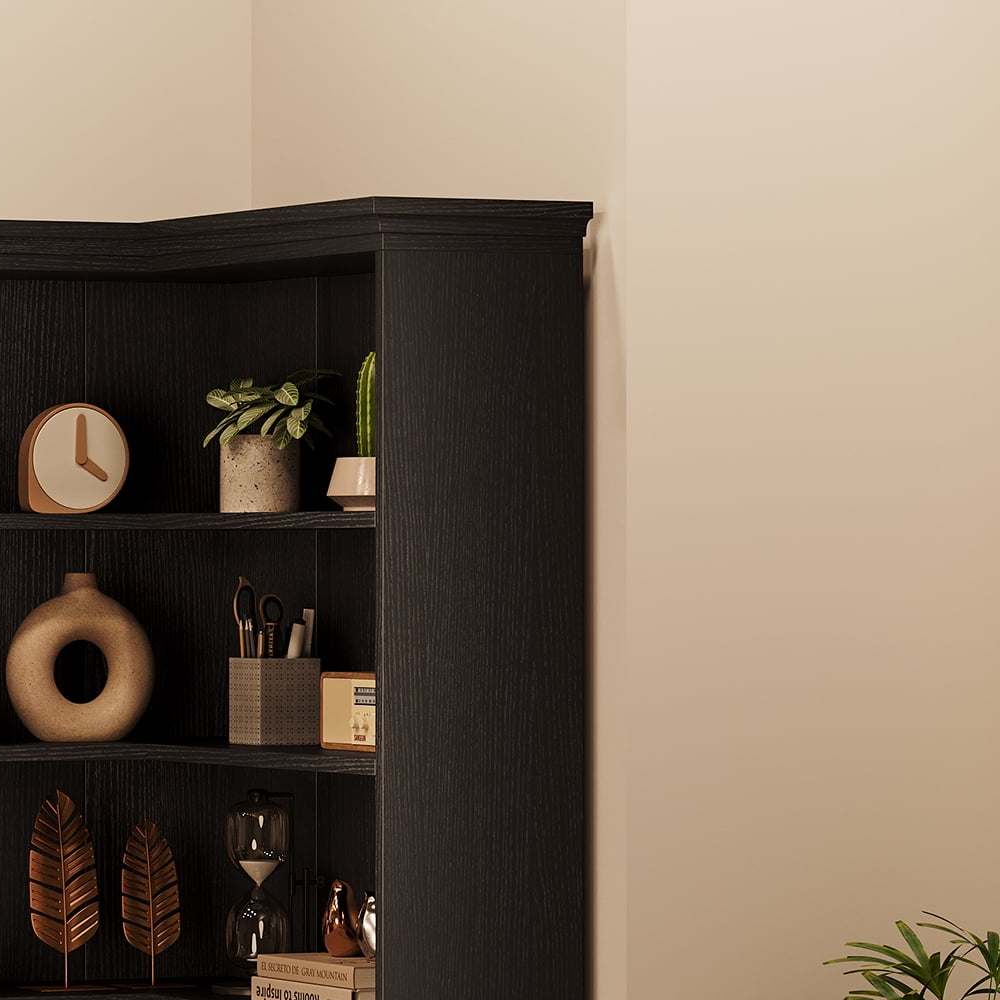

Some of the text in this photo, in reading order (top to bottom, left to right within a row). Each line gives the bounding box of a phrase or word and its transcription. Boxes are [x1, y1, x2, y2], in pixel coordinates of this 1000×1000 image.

[268, 962, 291, 974] SECRETO
[301, 967, 316, 977] GRAY
[316, 969, 348, 982] MOUNTAIN
